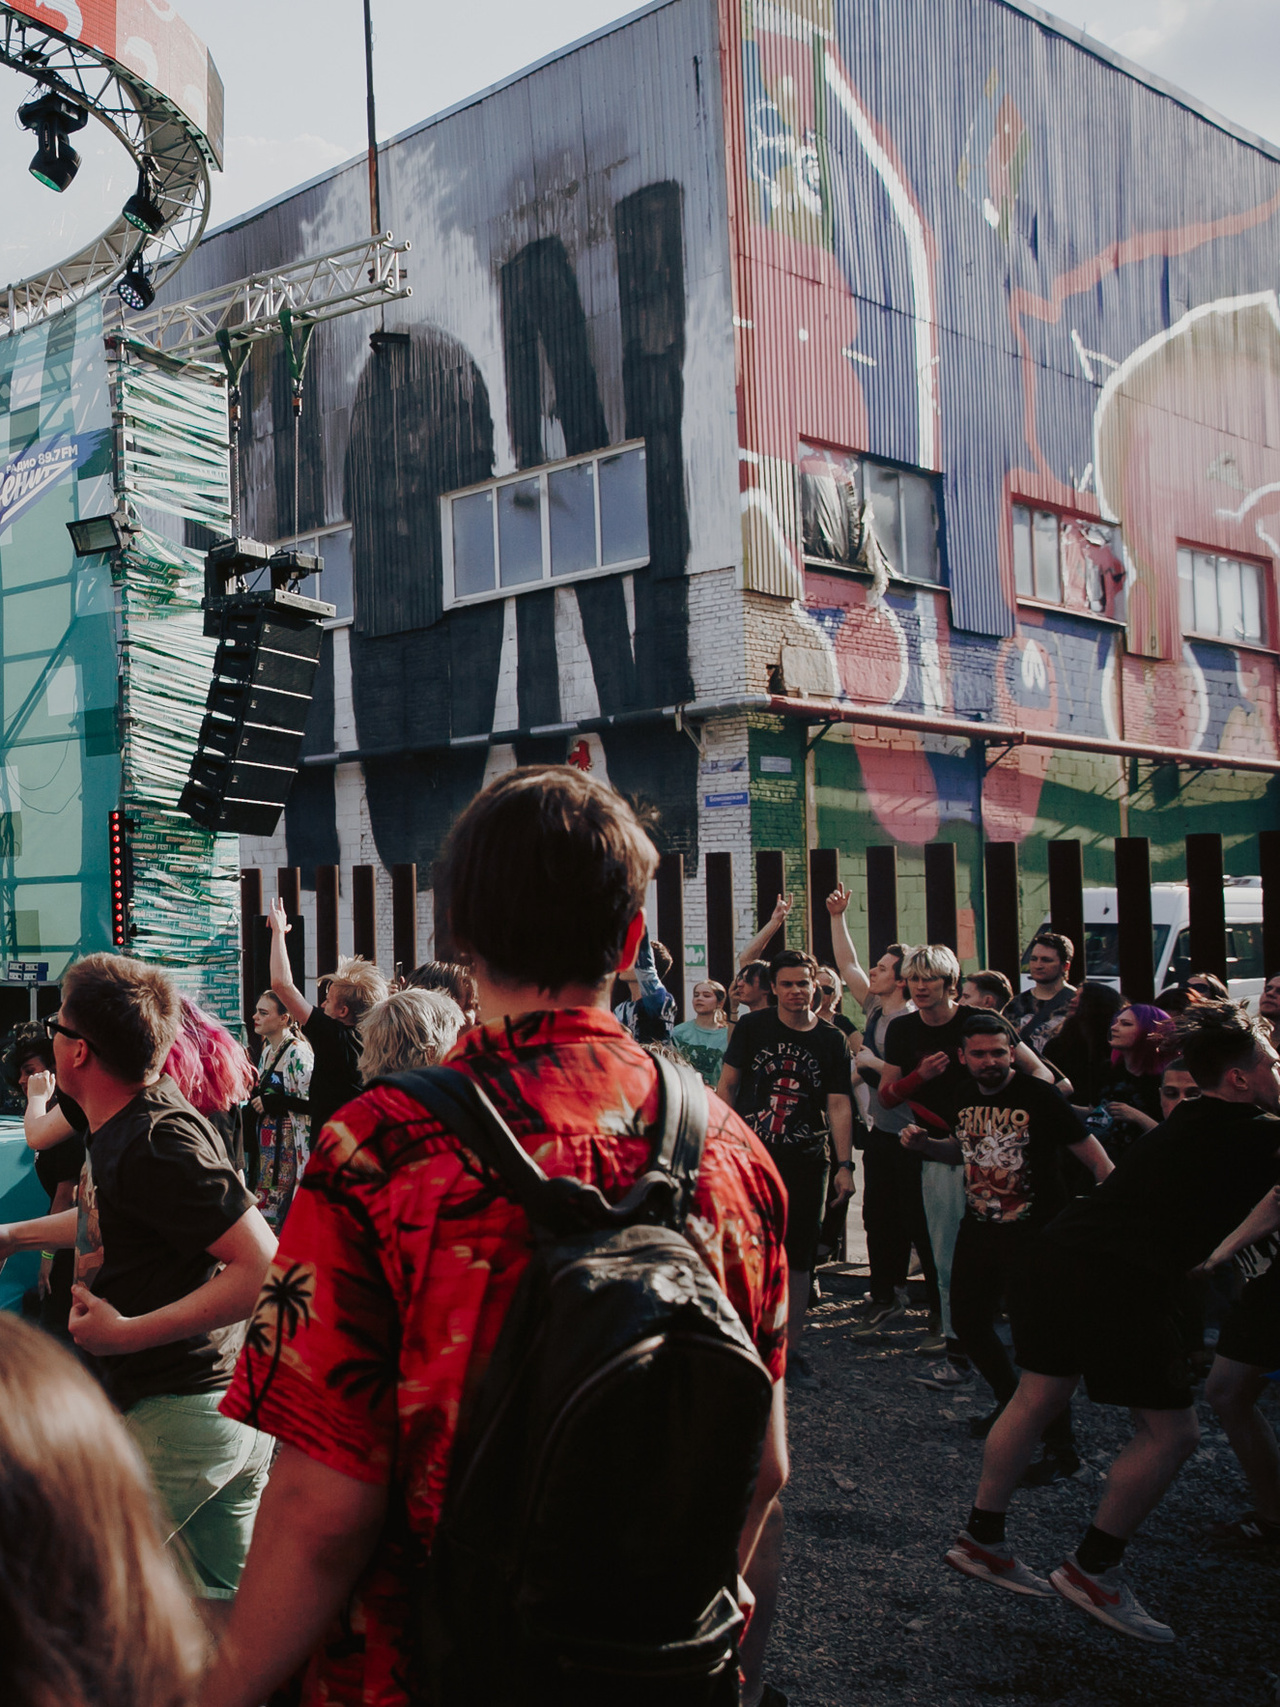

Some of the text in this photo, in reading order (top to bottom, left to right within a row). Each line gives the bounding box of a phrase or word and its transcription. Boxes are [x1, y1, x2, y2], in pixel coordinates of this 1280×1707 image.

[6, 459, 36, 474] РАДИО
[751, 1046, 774, 1071] SEX
[958, 1106, 1030, 1126] ESKIMO
